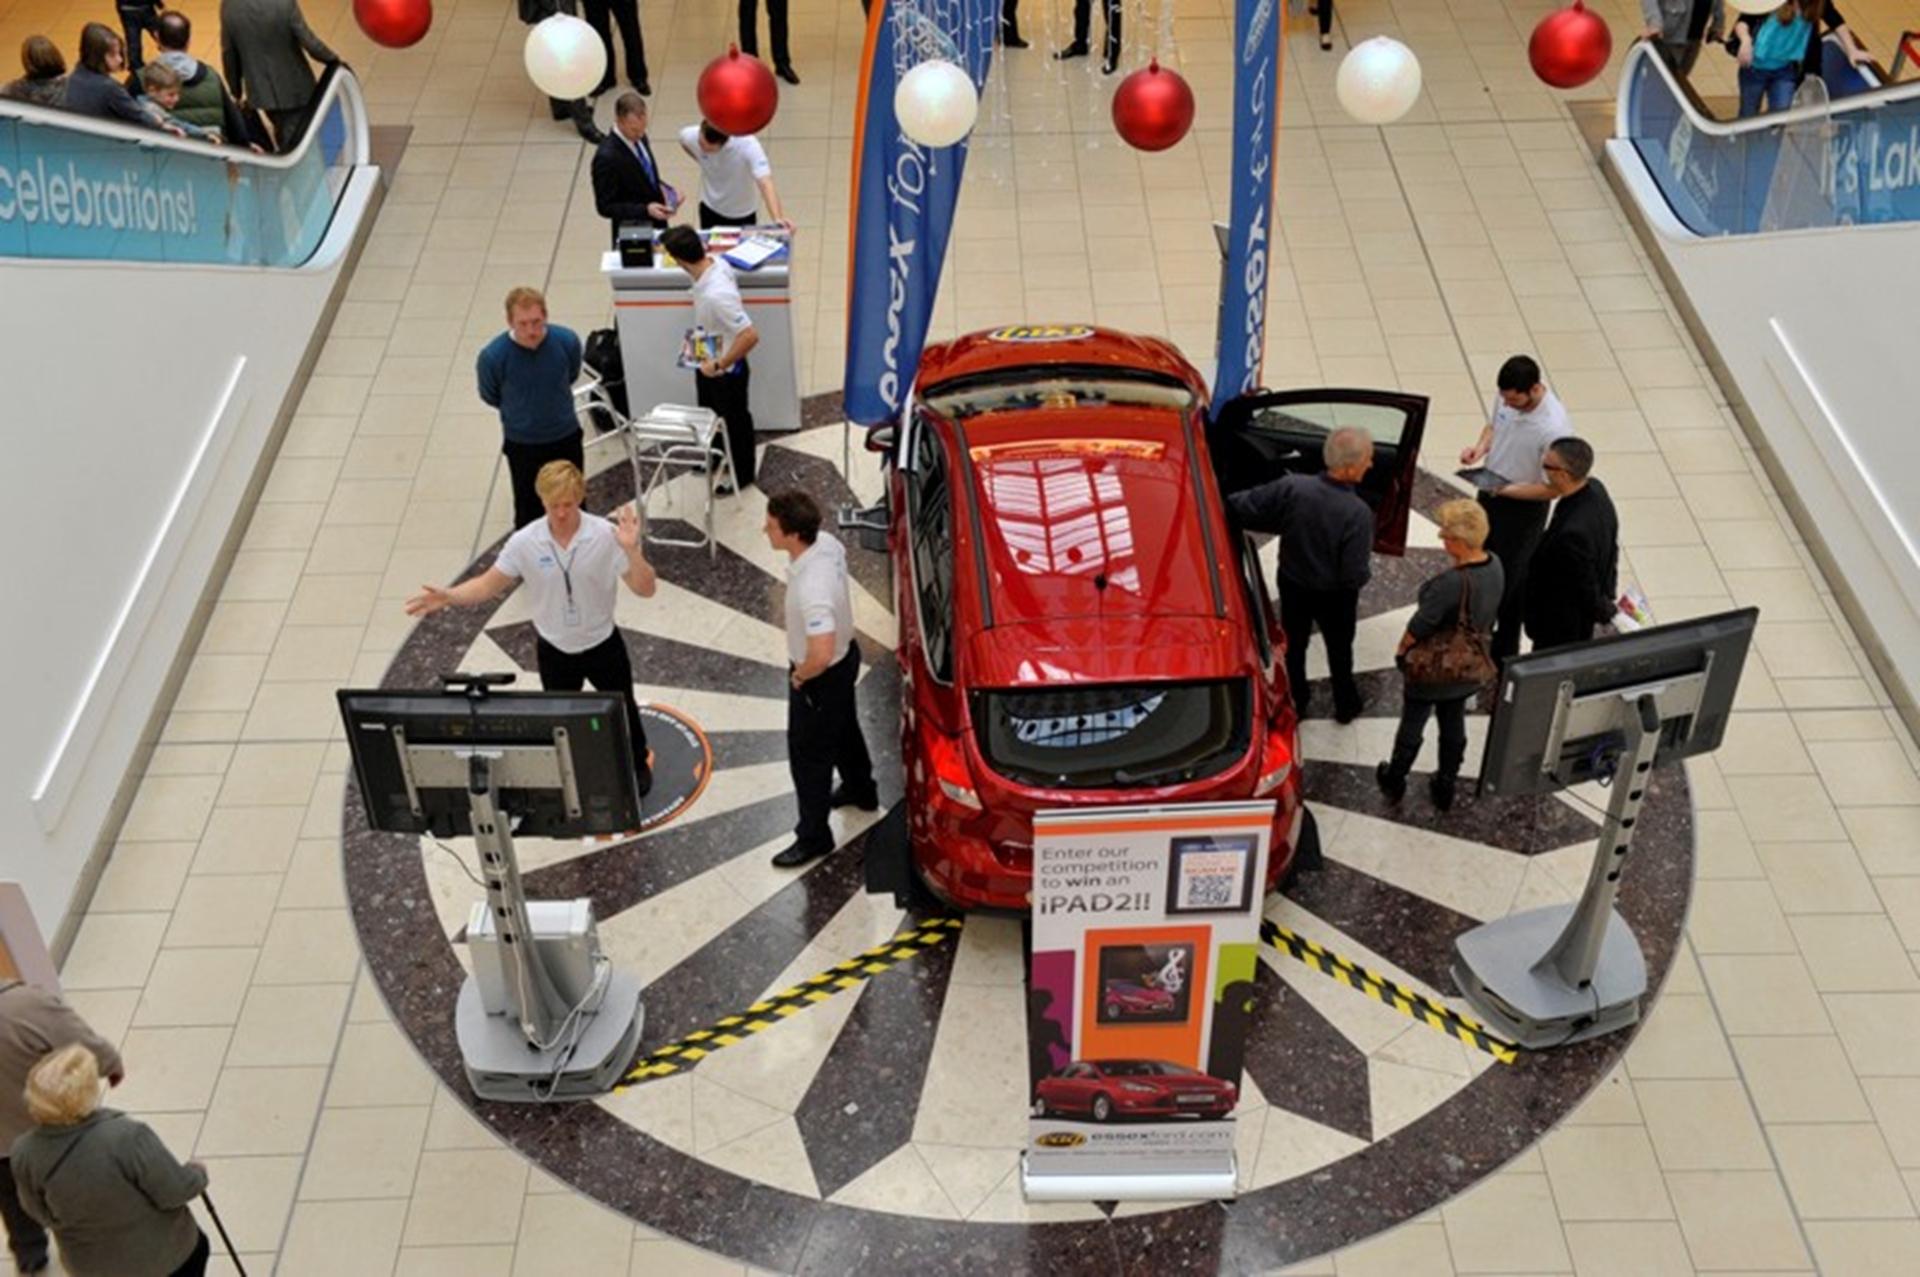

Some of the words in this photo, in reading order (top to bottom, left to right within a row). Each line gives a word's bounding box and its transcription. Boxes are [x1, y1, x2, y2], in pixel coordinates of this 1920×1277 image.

[0, 156, 197, 236] celebrations!
[1041, 847, 1092, 862] Enter
[1097, 846, 1129, 858] our
[1040, 858, 1160, 878] competition
[1041, 876, 1061, 889] to
[1065, 873, 1101, 888] win
[1105, 875, 1131, 885] an
[1040, 892, 1151, 916] iPAD2!!
